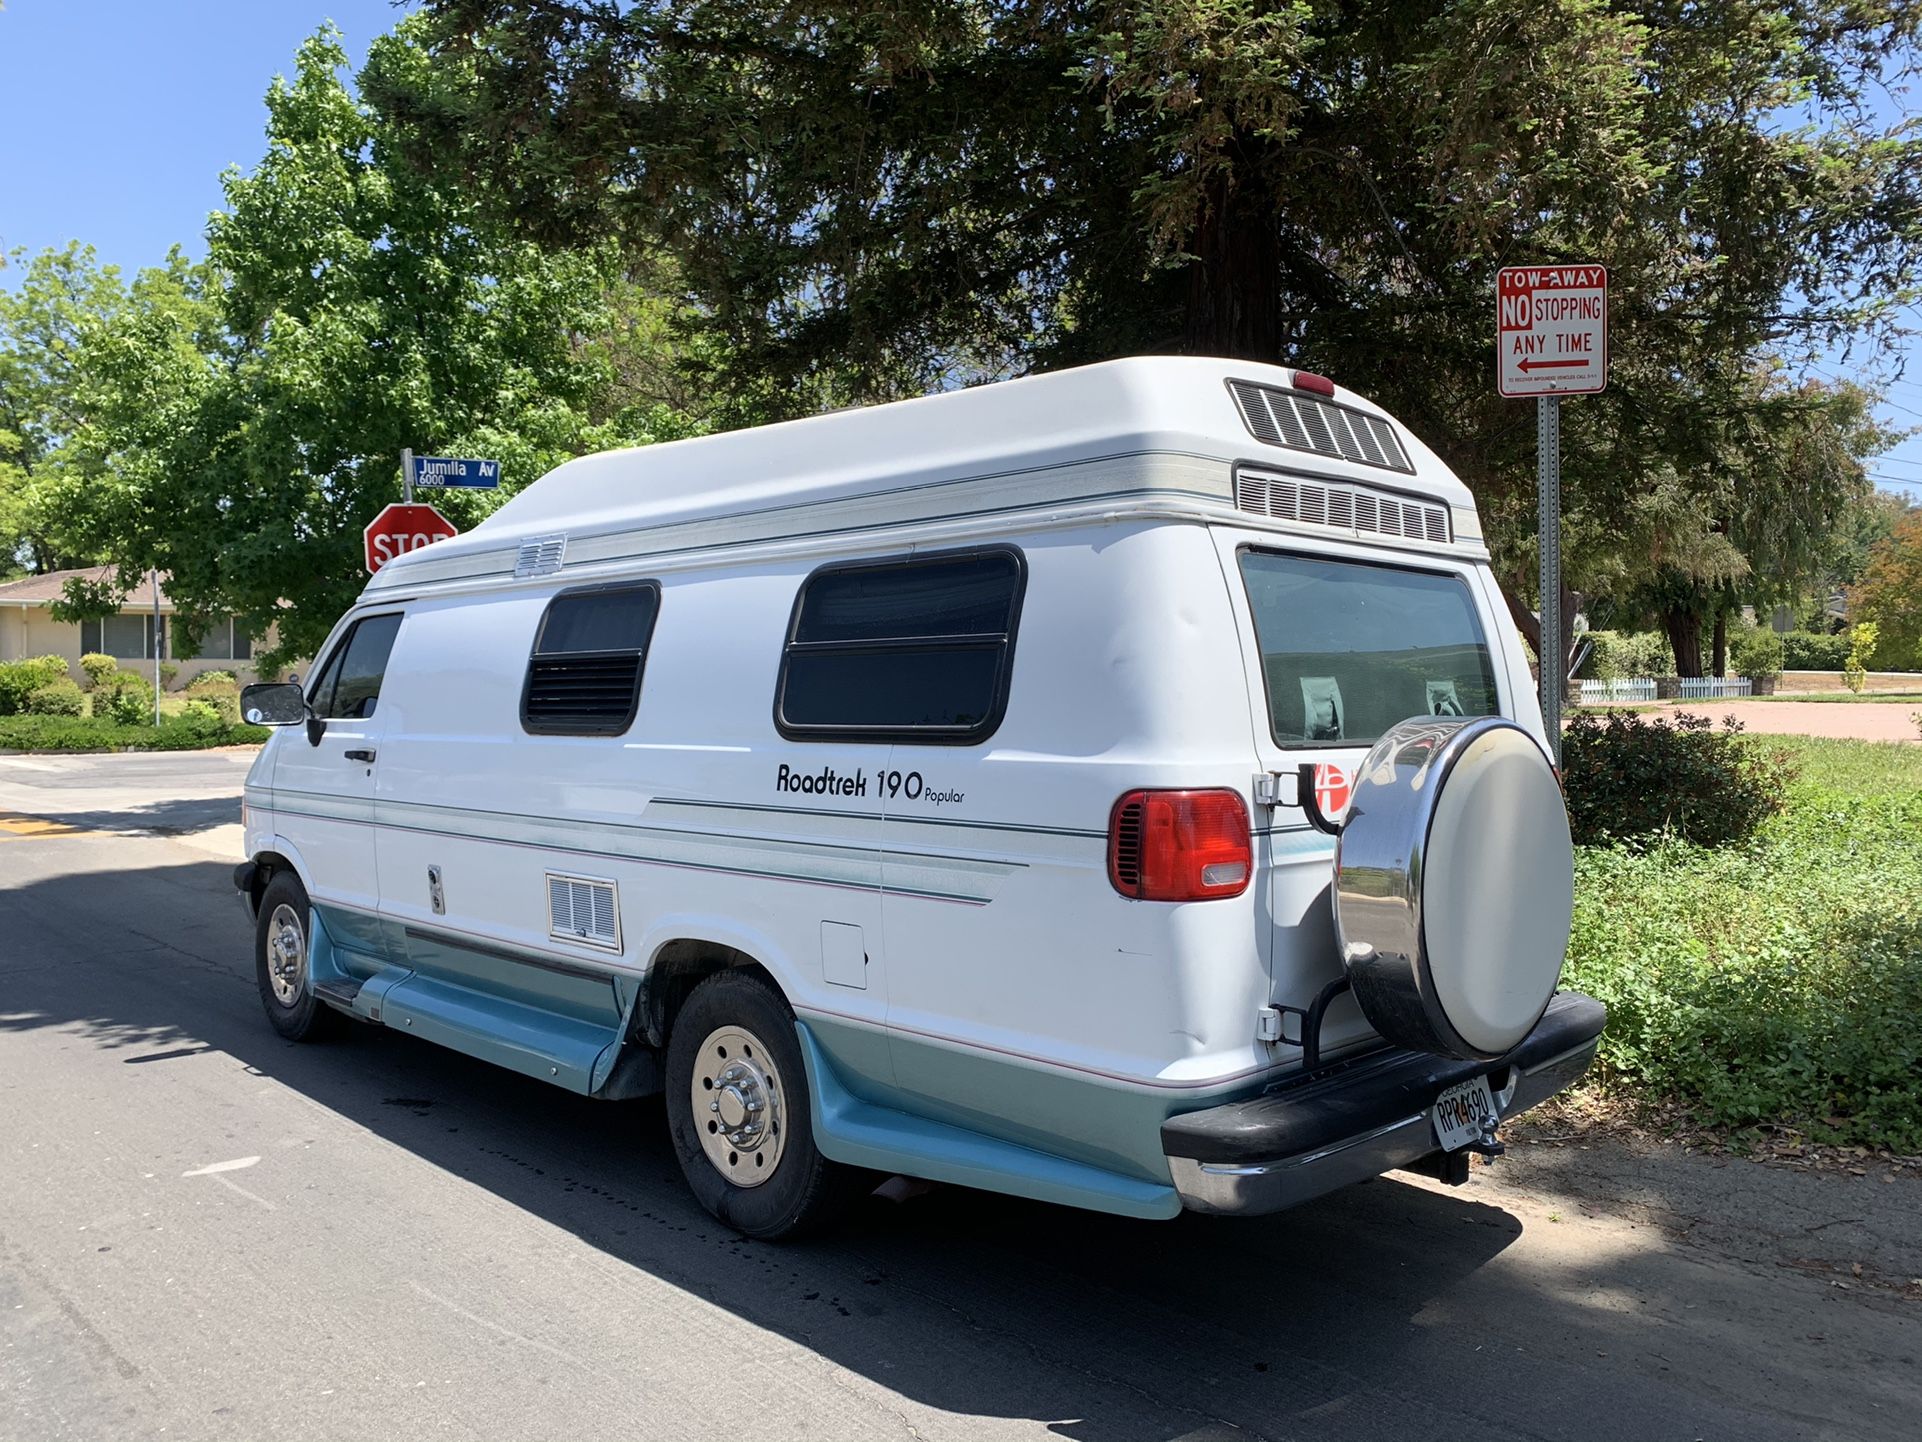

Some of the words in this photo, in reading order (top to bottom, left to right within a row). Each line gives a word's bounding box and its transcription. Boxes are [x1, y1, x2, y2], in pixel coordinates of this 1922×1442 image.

[1502, 269, 1602, 288] TOW-AWAY
[1502, 294, 1531, 327] NO
[1535, 296, 1600, 321] STOPPING
[1513, 335, 1546, 354] ANY
[1556, 333, 1592, 352] TIME
[419, 460, 467, 476] Jumilla
[479, 462, 495, 477] Av
[419, 474, 445, 485] 6000
[776, 764, 867, 797] Roadtrek
[877, 770, 923, 800] 190
[925, 787, 965, 806] Popular
[1437, 1088, 1489, 1133] RPR4690
